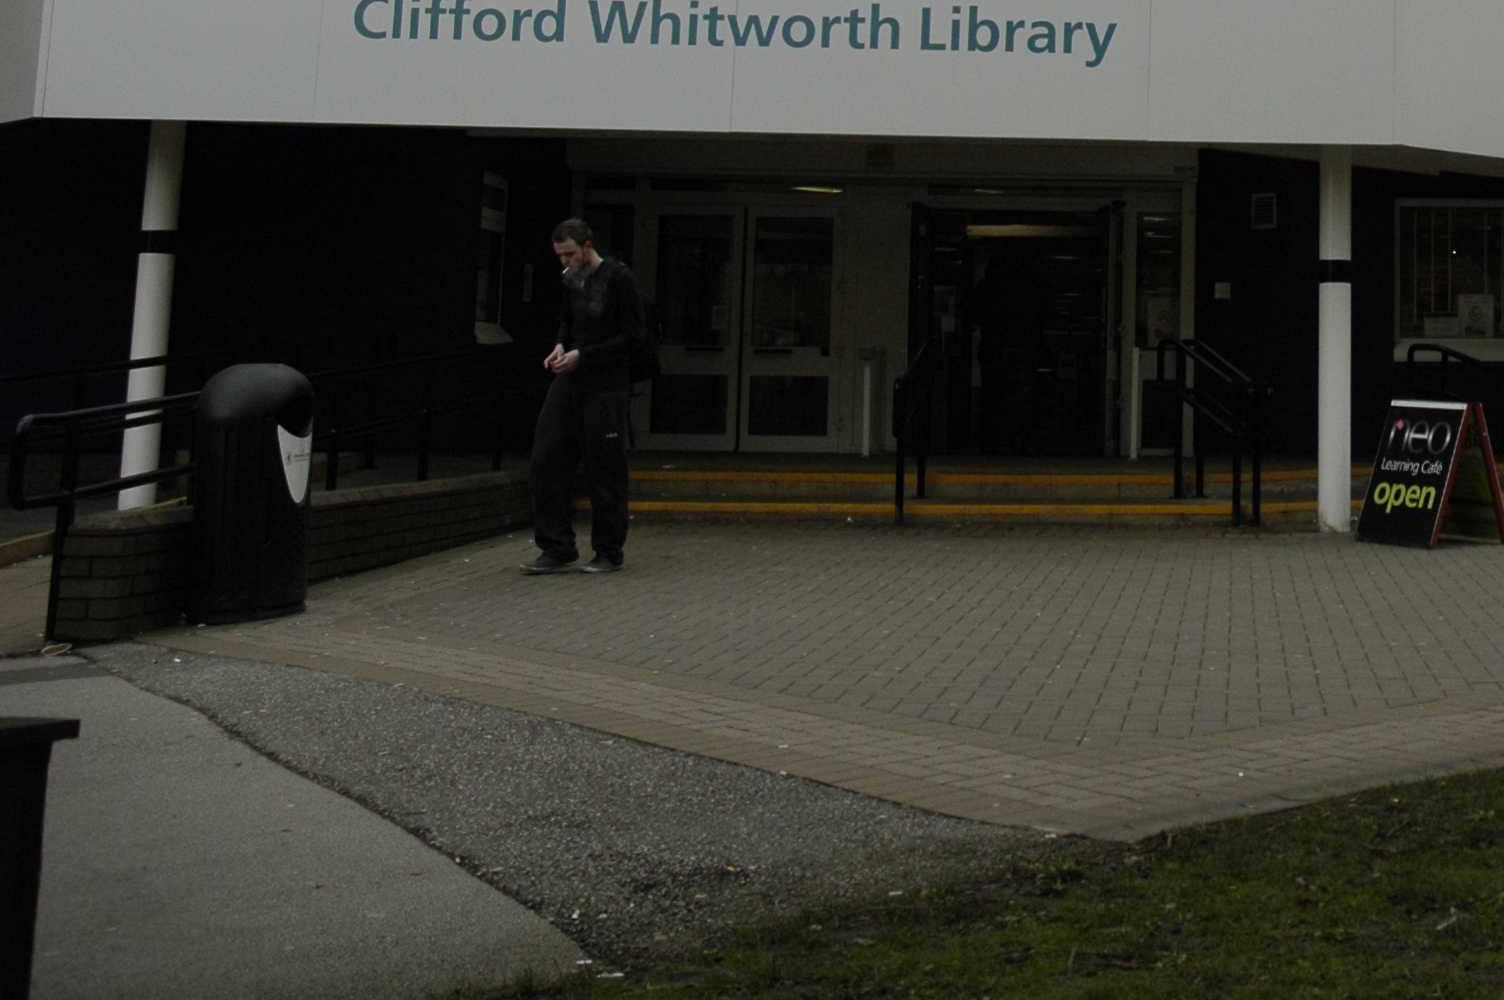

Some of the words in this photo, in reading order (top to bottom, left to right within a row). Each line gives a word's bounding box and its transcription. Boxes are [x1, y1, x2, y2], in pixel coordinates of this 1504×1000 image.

[589, 0, 901, 51] Whitworth
[920, 5, 1118, 68] Library
[1387, 418, 1453, 456] neo
[1380, 456, 1420, 477] Learning
[1421, 460, 1443, 476] Café
[1373, 481, 1437, 515] open
